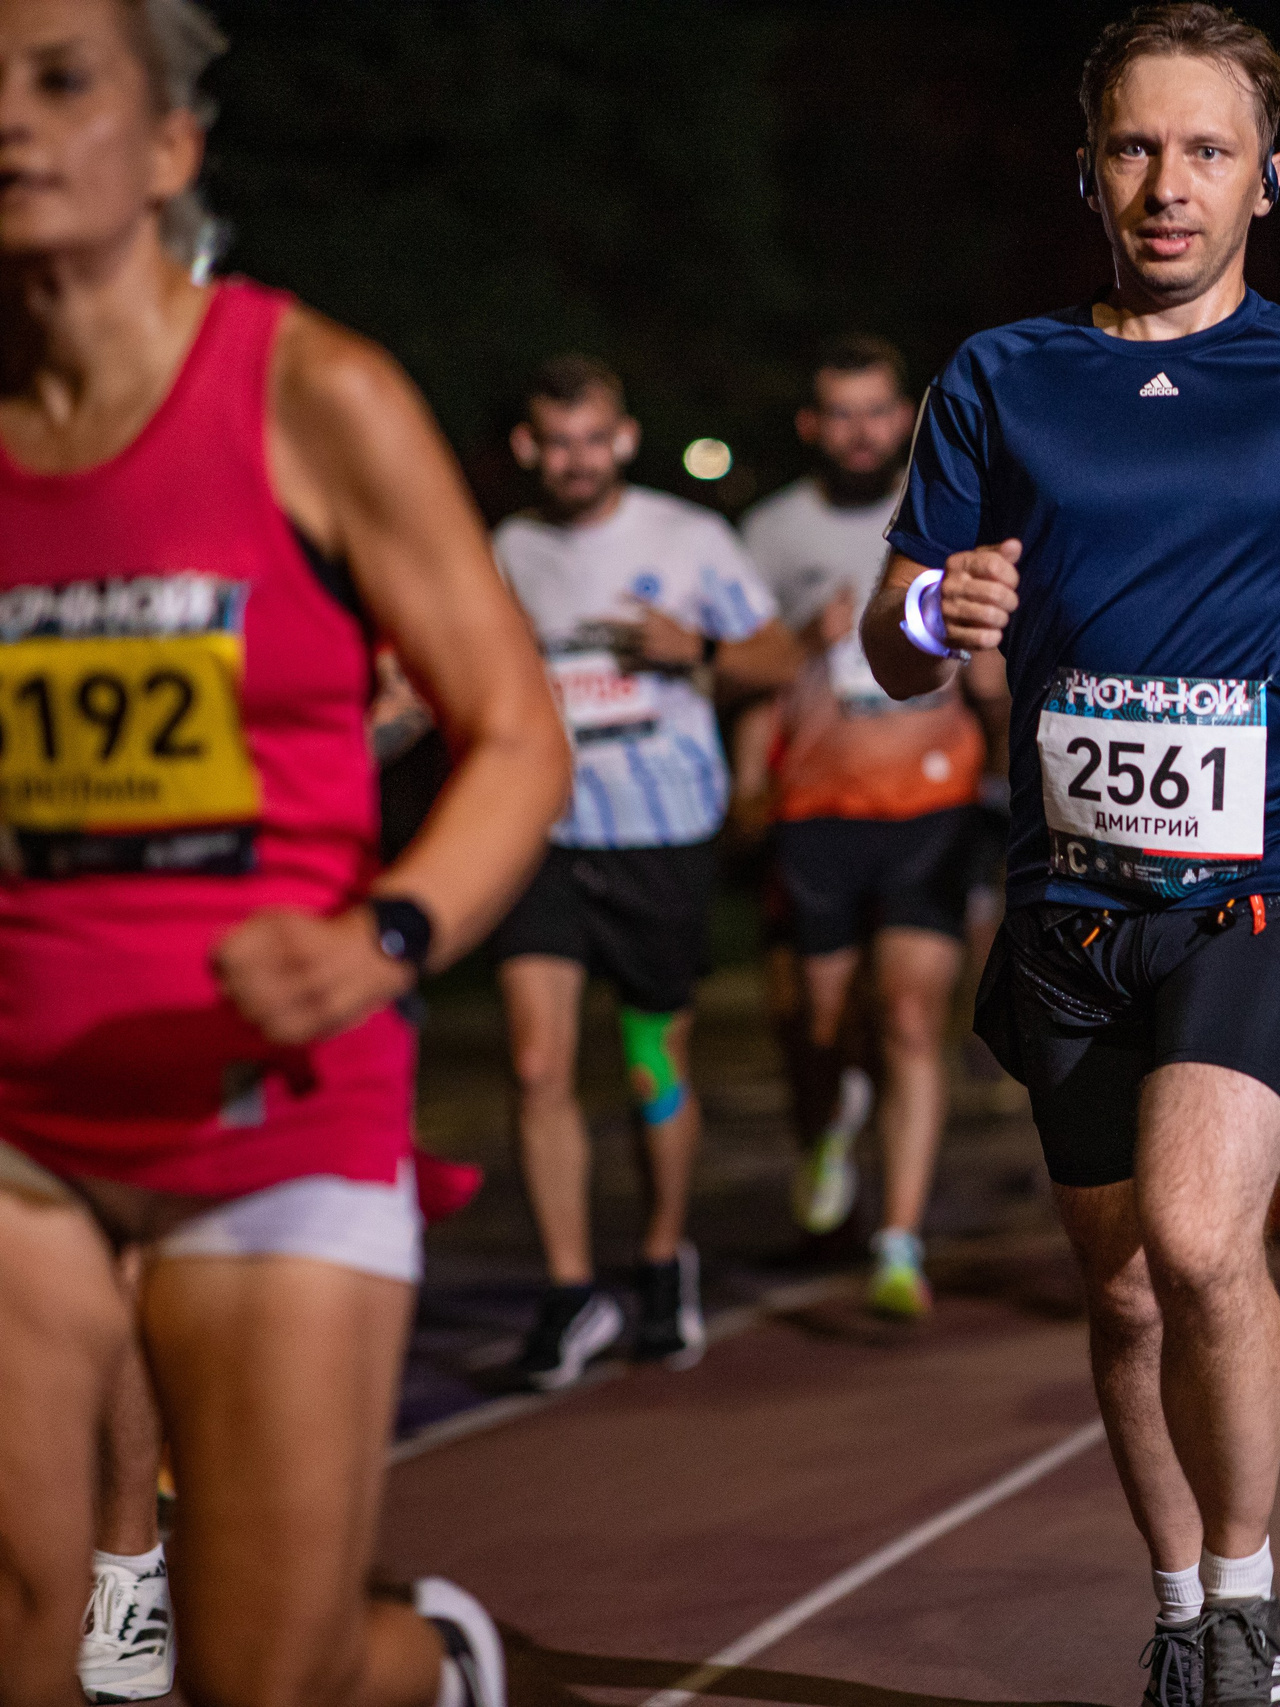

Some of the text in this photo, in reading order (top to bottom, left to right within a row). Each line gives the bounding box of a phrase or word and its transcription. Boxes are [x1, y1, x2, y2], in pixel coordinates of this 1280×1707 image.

[1139, 386, 1179, 397] adidas
[1066, 670, 1250, 716] НОЧНОЙ
[0, 673, 208, 763] 192
[1066, 737, 1227, 812] 2561
[1095, 811, 1199, 838] ДМИТРИЙ
